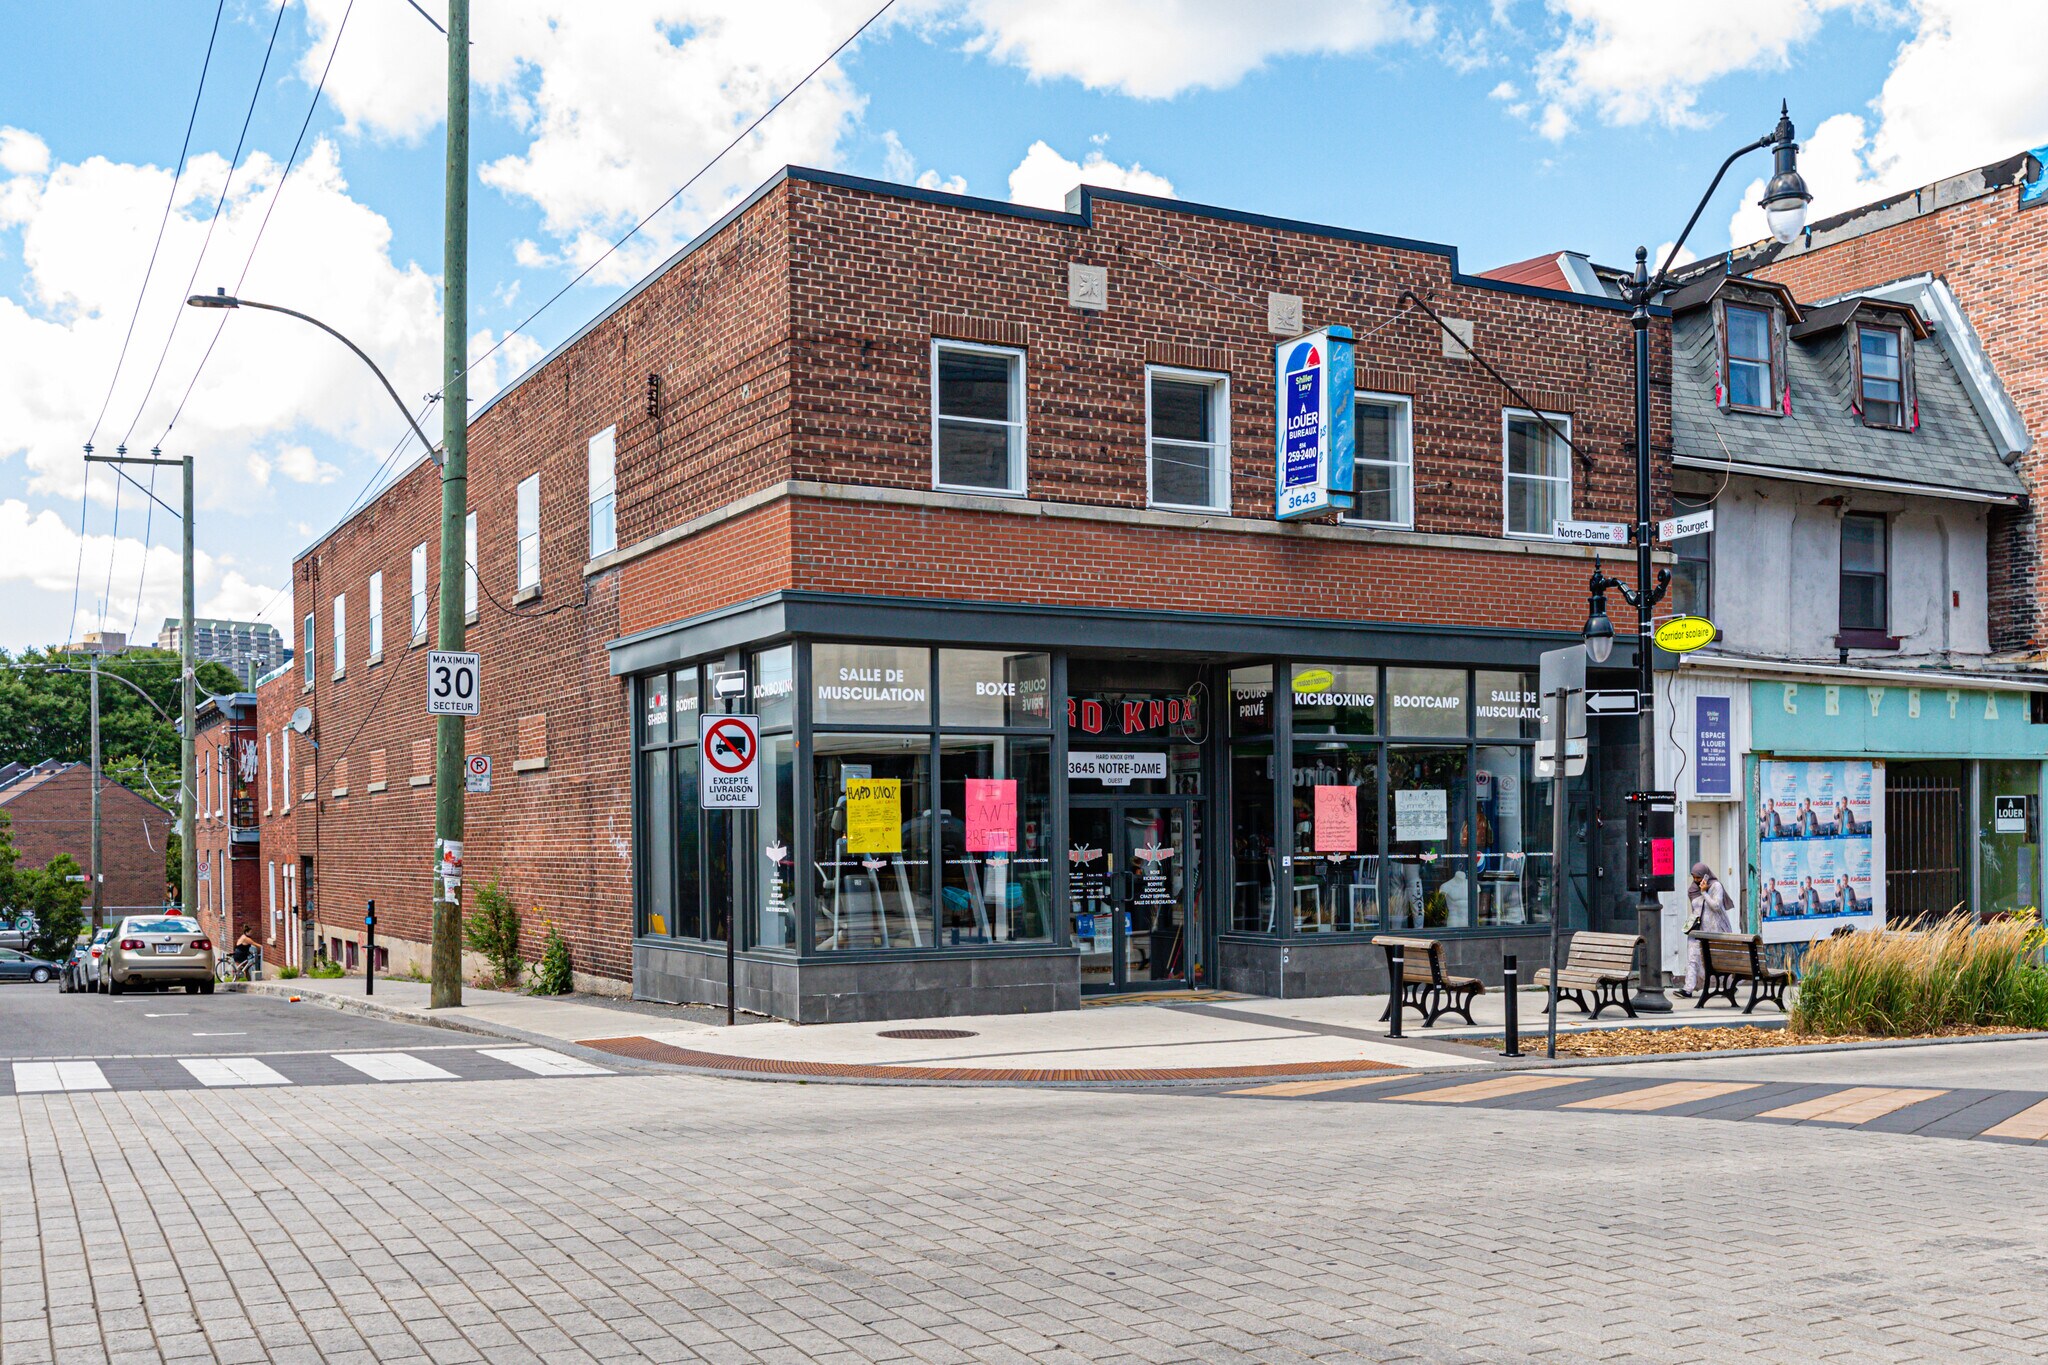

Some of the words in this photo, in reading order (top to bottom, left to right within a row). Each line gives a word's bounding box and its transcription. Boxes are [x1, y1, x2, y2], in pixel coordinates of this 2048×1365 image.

[1296, 375, 1313, 385] Shiller
[1299, 383, 1311, 392] Lavy
[1289, 412, 1318, 430] LOUER
[1289, 426, 1317, 440] BUREAUX
[1288, 447, 1317, 463] 259-2400
[1289, 492, 1316, 509] 3643
[1558, 527, 1610, 540] Notre-Dame
[1677, 520, 1708, 534] Bourget
[1660, 630, 1684, 641] Corridor
[1685, 627, 1709, 638] scolaire
[433, 655, 475, 665] MAXIMUM
[434, 666, 473, 698] 30
[840, 667, 881, 682] SALLE
[886, 669, 904, 683] DE
[818, 686, 925, 702] MUSCULATION
[976, 681, 1016, 696] BOXE
[1236, 688, 1267, 701] COURS
[649, 697, 655, 709] LE
[1295, 692, 1374, 707] KICKBOXING
[1394, 695, 1460, 709] BOOTCAMP
[1491, 690, 1520, 702] SALLE
[1523, 692, 1536, 703] DE
[433, 702, 473, 711] SECTEUR
[676, 697, 698, 713] BODYFIT
[1240, 701, 1264, 718] PRIVÉ
[1068, 698, 1103, 734] RD
[1124, 700, 1192, 735] KNOX
[1476, 706, 1541, 719] MUSCULATIO
[1701, 731, 1726, 739] ESPACE
[1068, 762, 1095, 774] 3645
[1098, 763, 1161, 774] NOTRE-DAME
[713, 776, 749, 785] EXCEPTÉ
[709, 785, 753, 793] LIVRAISON
[847, 785, 871, 801] HARD
[873, 786, 897, 800] KNOX
[986, 784, 997, 797] I
[716, 794, 747, 802] LOCALE
[1998, 809, 2023, 818] LOUER
[967, 827, 1015, 848] BREATHE
